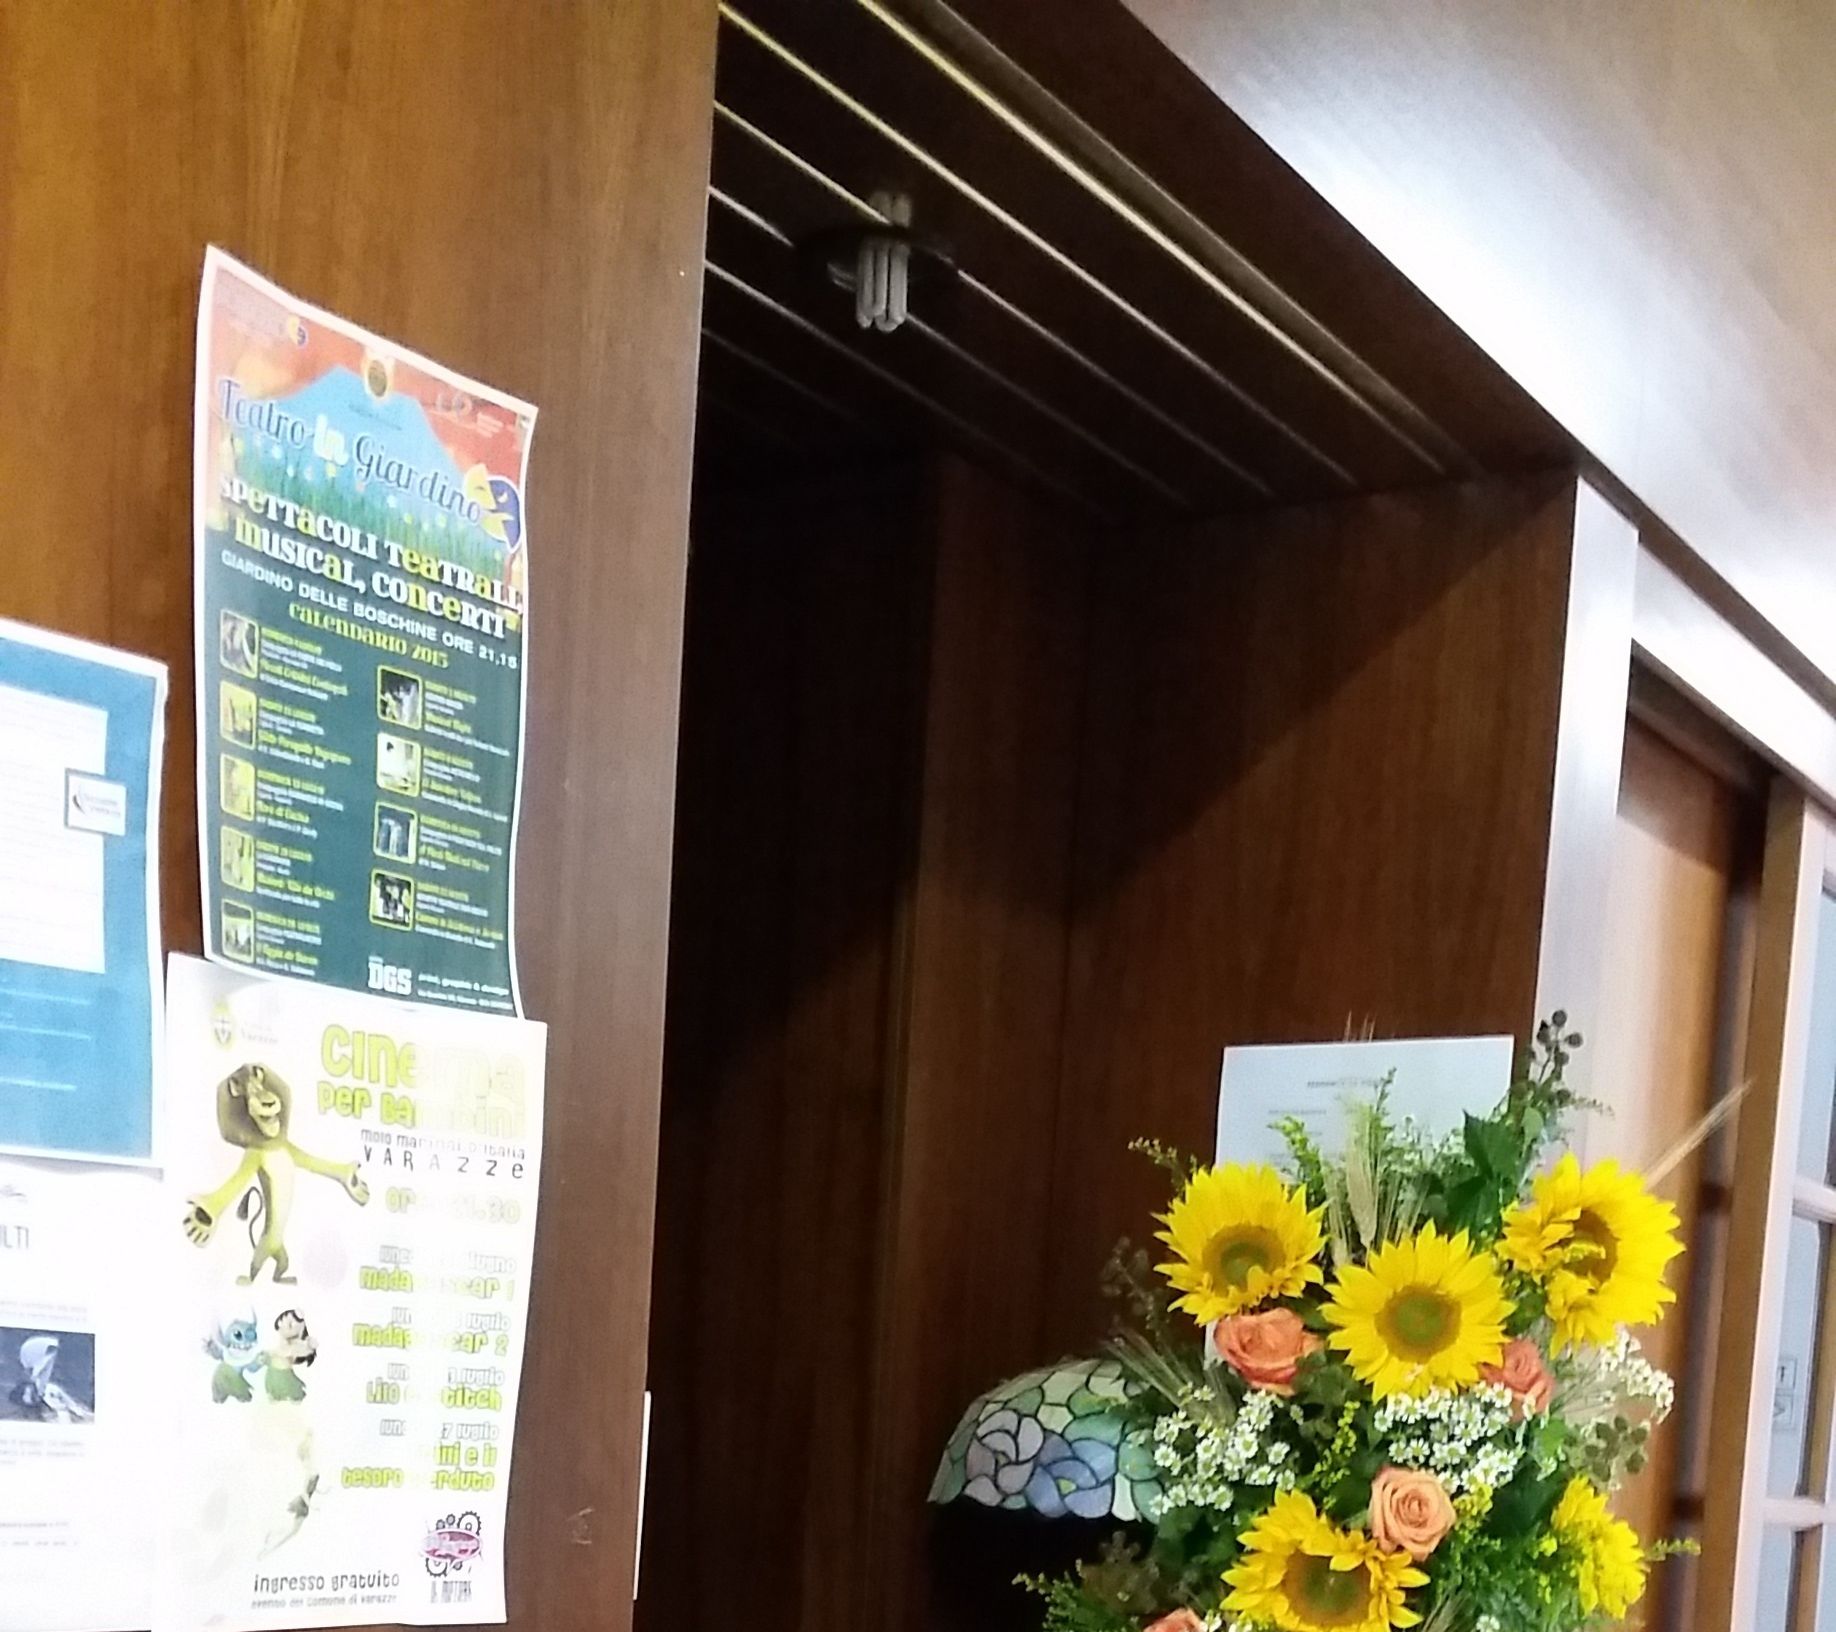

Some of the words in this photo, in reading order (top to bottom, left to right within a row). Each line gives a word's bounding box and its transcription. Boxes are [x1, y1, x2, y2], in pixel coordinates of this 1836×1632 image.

[218, 380, 309, 447] Teatro
[353, 434, 482, 523] Giardino
[221, 550, 293, 592] GIARDINO
[299, 582, 349, 612] DELLE
[353, 602, 438, 642] BOSCHINE
[441, 630, 474, 654] ORE
[254, 1574, 326, 1594] ingresso
[331, 1570, 400, 1592] gratuito
